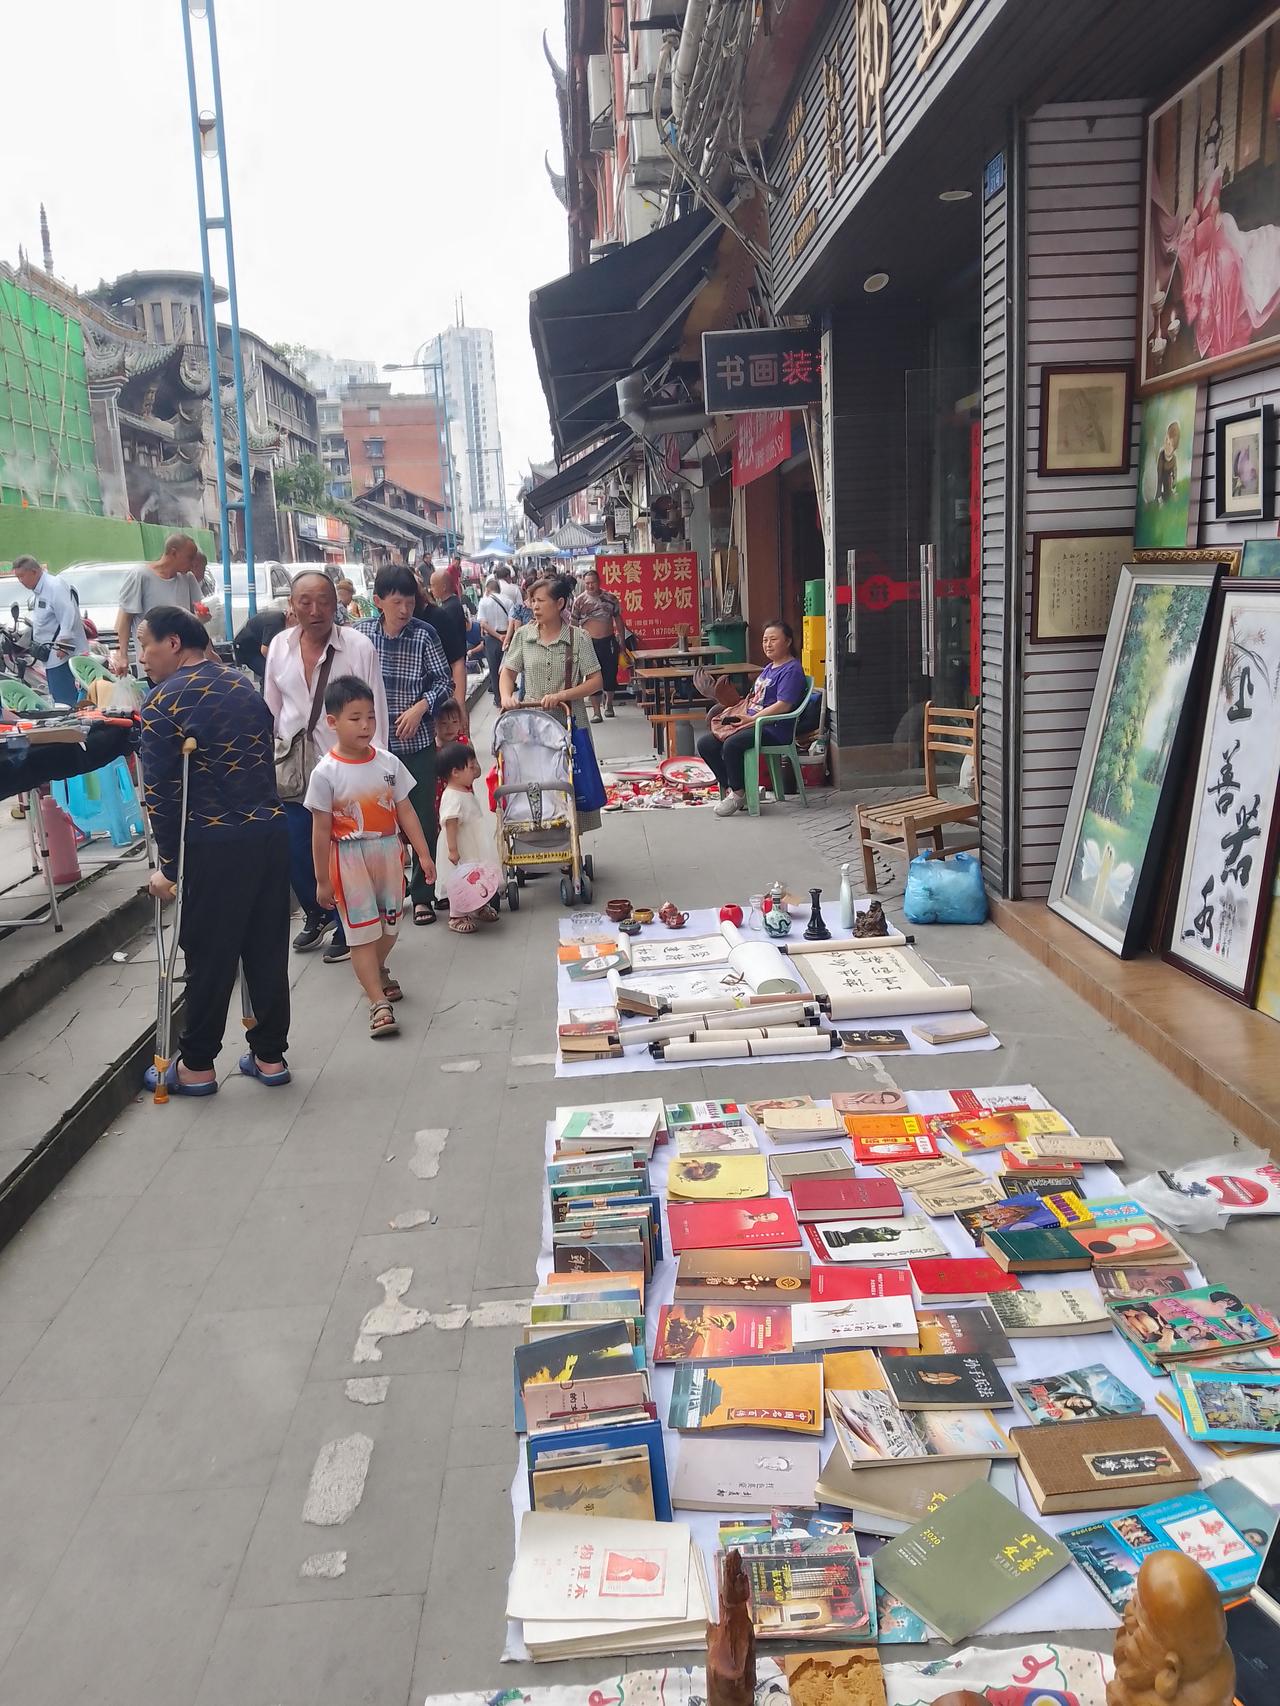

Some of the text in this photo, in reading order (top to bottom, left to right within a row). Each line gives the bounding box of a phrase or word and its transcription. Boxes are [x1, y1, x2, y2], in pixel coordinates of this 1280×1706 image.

[716, 350, 823, 390] 书画装
[602, 557, 692, 584] 快餐 炒菜
[653, 586, 692, 611] 炒饭
[1181, 665, 1262, 949] 上善若水
[962, 1357, 995, 1399] 孙子兵法
[922, 1527, 942, 1546] 2020
[574, 1544, 596, 1600] 物理本
[994, 1552, 1022, 1577] YIBIN
